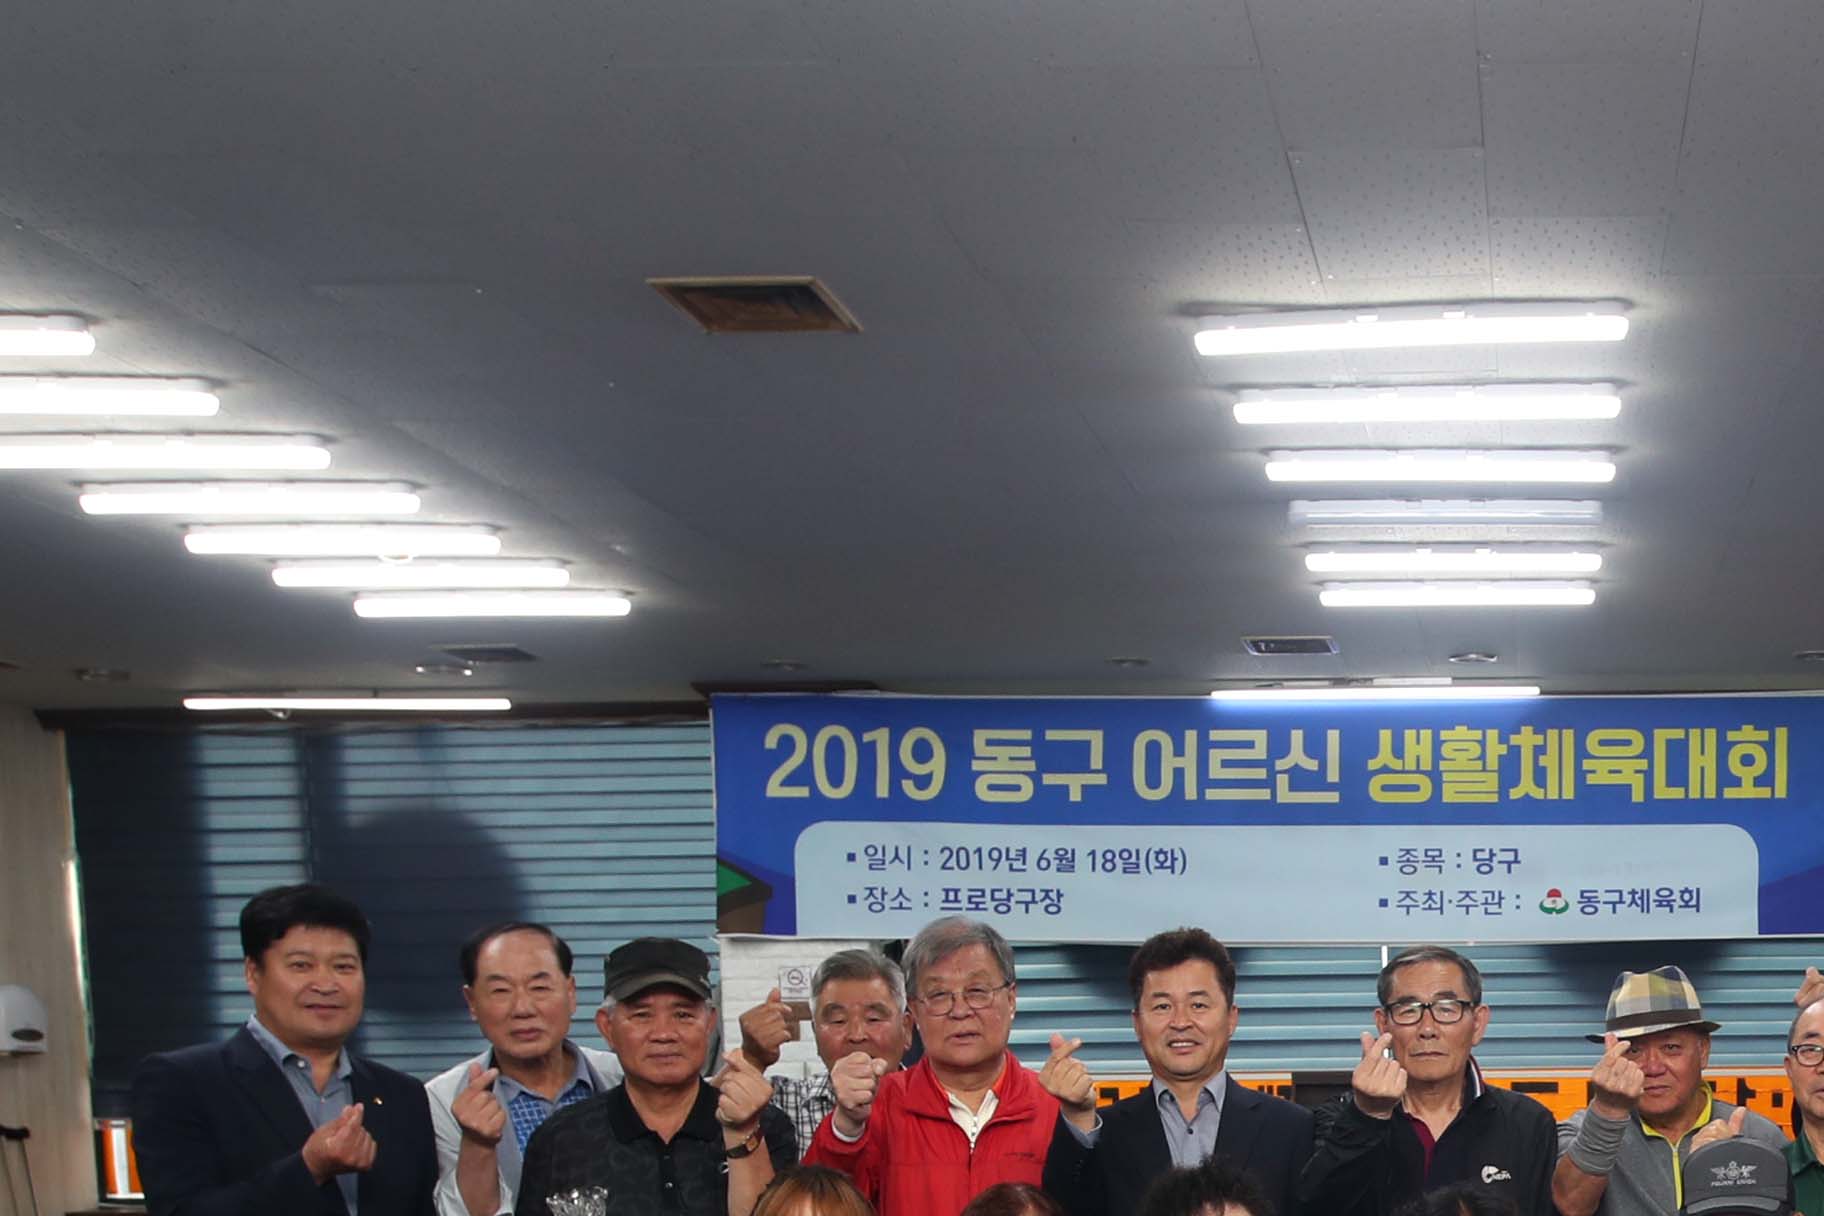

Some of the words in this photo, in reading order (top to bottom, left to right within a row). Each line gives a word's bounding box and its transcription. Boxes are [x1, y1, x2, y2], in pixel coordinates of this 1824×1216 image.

[766, 725, 945, 800] 2019
[972, 730, 1107, 802] 동구
[1133, 729, 1339, 803] 어르신
[1368, 725, 1787, 802] 생활체육대회
[864, 845, 911, 871] 일시
[940, 846, 1026, 872] 2019년
[1037, 848, 1075, 873] 6월
[1087, 848, 1186, 875] 18일(화)
[1397, 849, 1445, 875] 종목
[1473, 849, 1520, 875] 당구
[864, 887, 912, 913] 장소
[940, 888, 1064, 915] 프로당구장
[1578, 887, 1700, 915] 동구체육회
